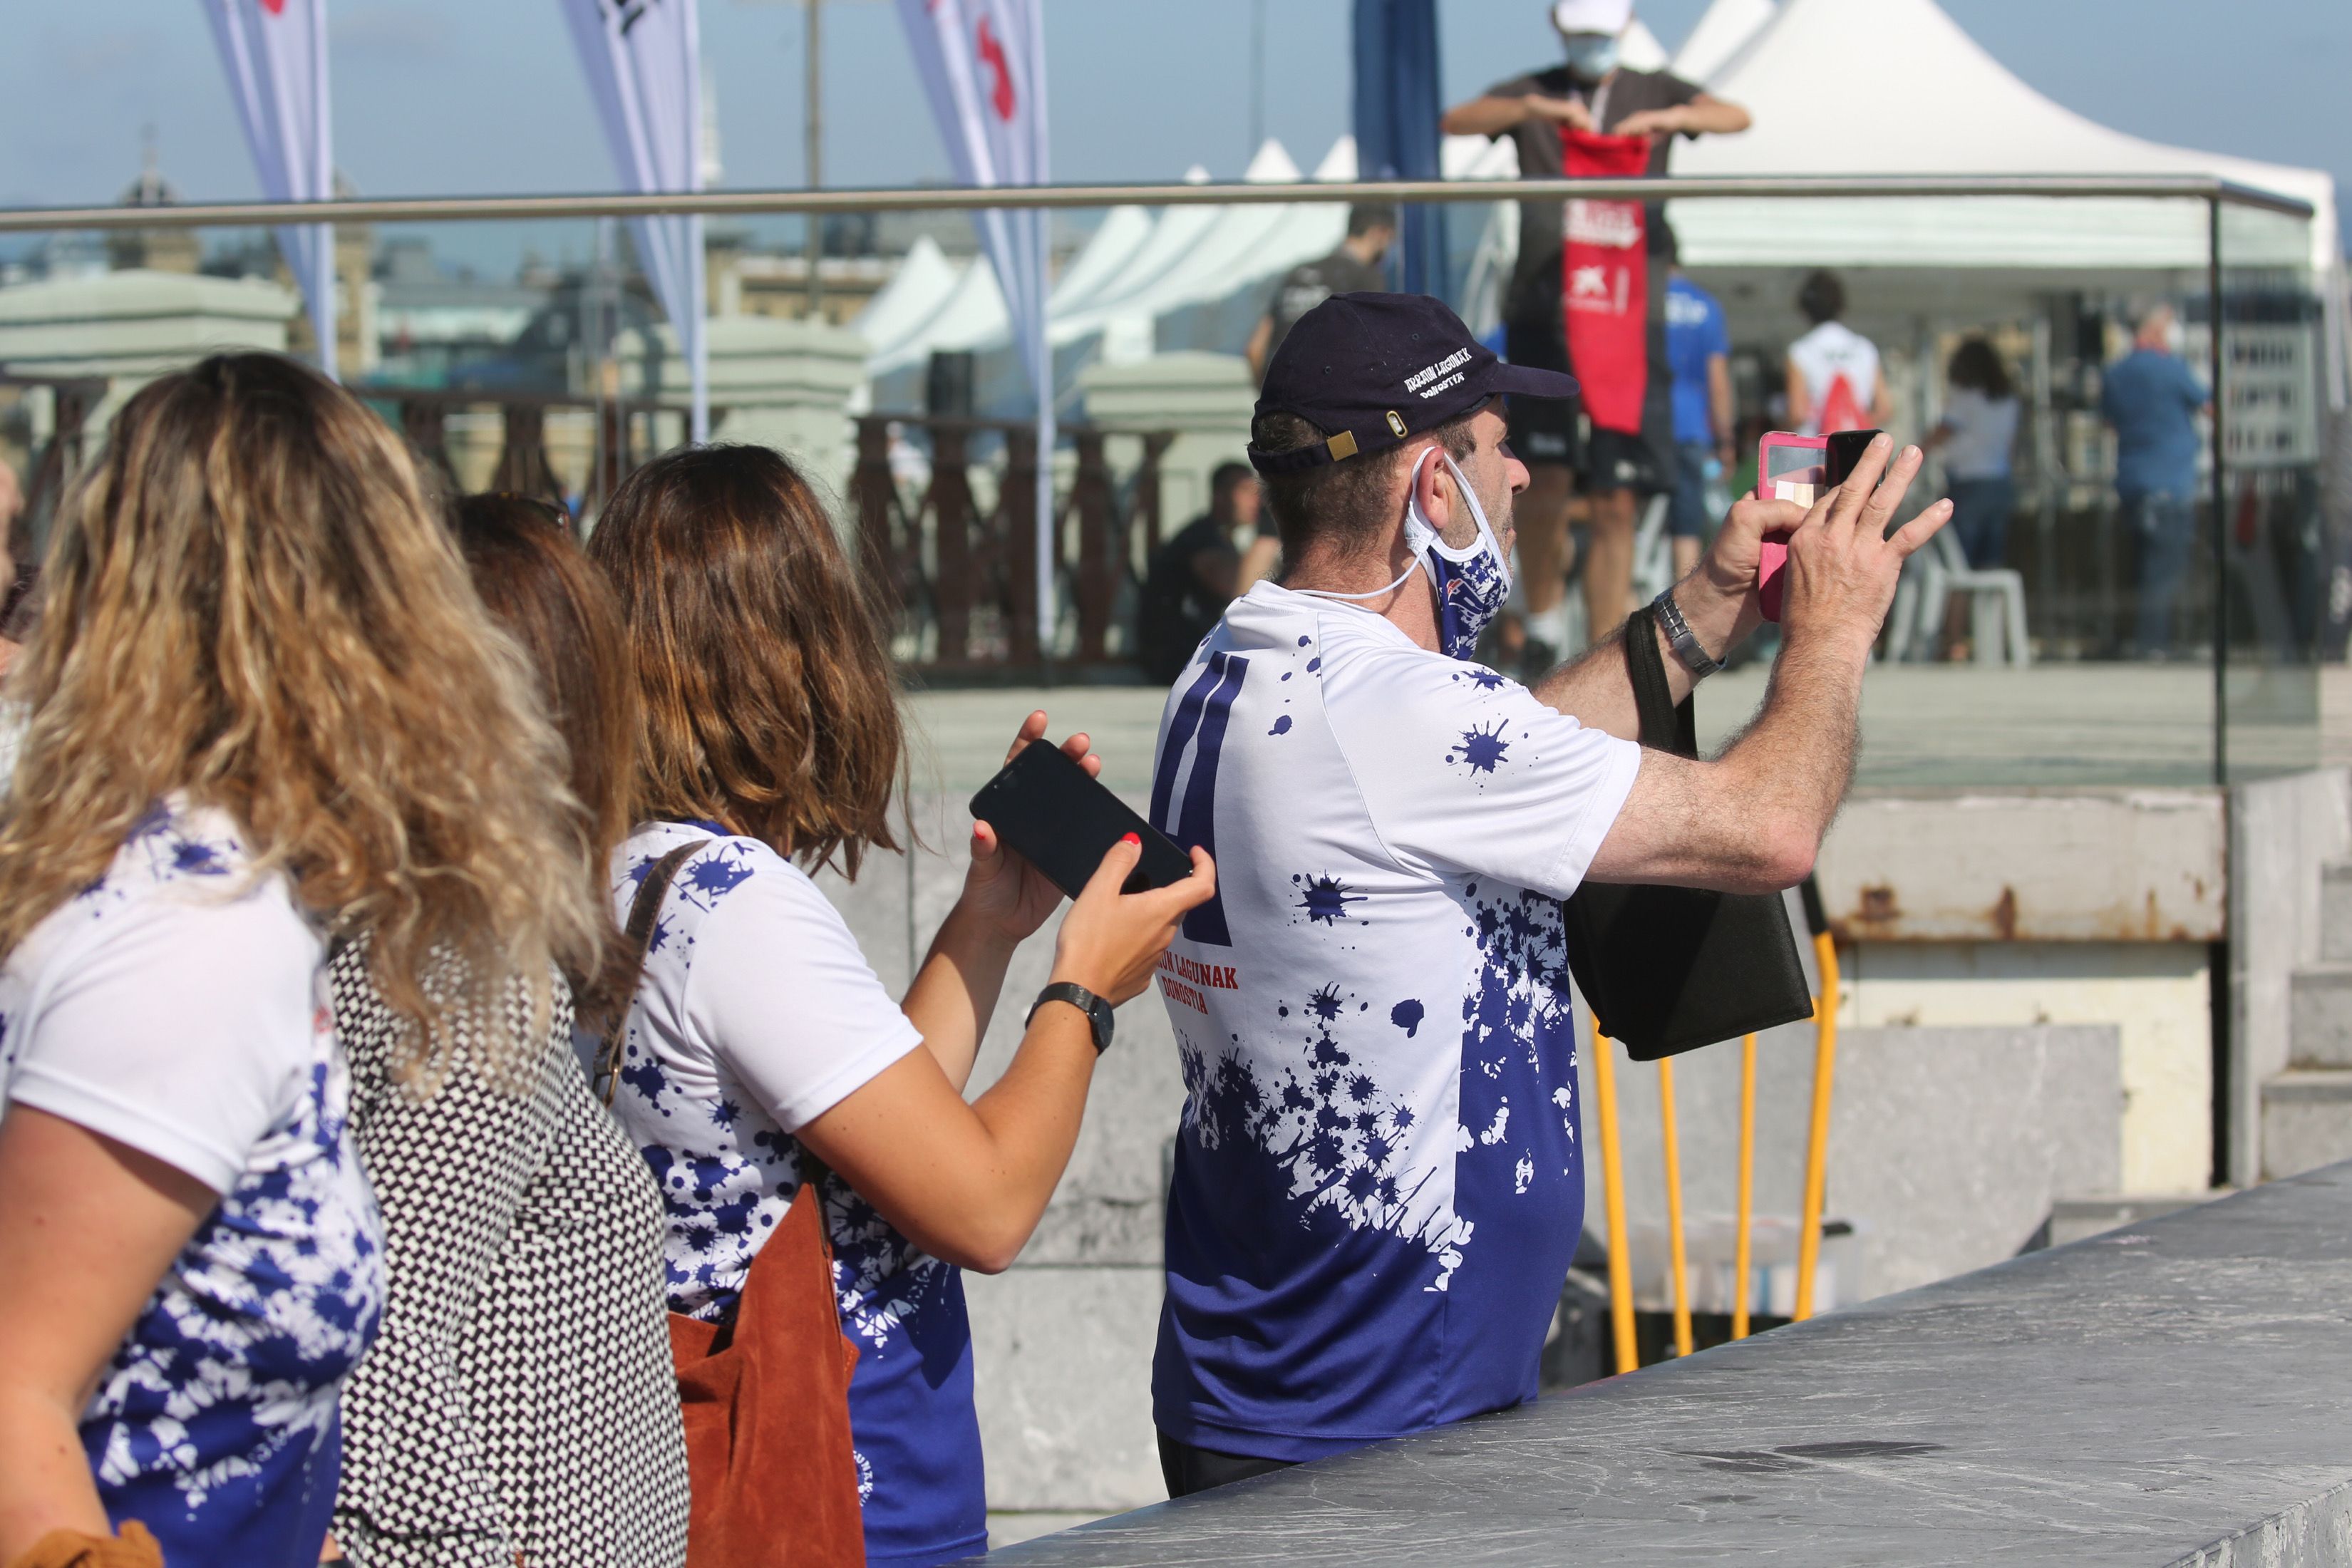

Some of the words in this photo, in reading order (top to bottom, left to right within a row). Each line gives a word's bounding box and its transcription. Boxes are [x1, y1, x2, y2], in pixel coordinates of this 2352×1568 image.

[1404, 366, 1438, 393] ARRAUN
[1434, 347, 1472, 376] LAGUNAK
[1420, 371, 1465, 399] DONOSTIA
[1175, 954, 1239, 990] LAGUNAK
[1161, 975, 1209, 1015] DONOSTIA
